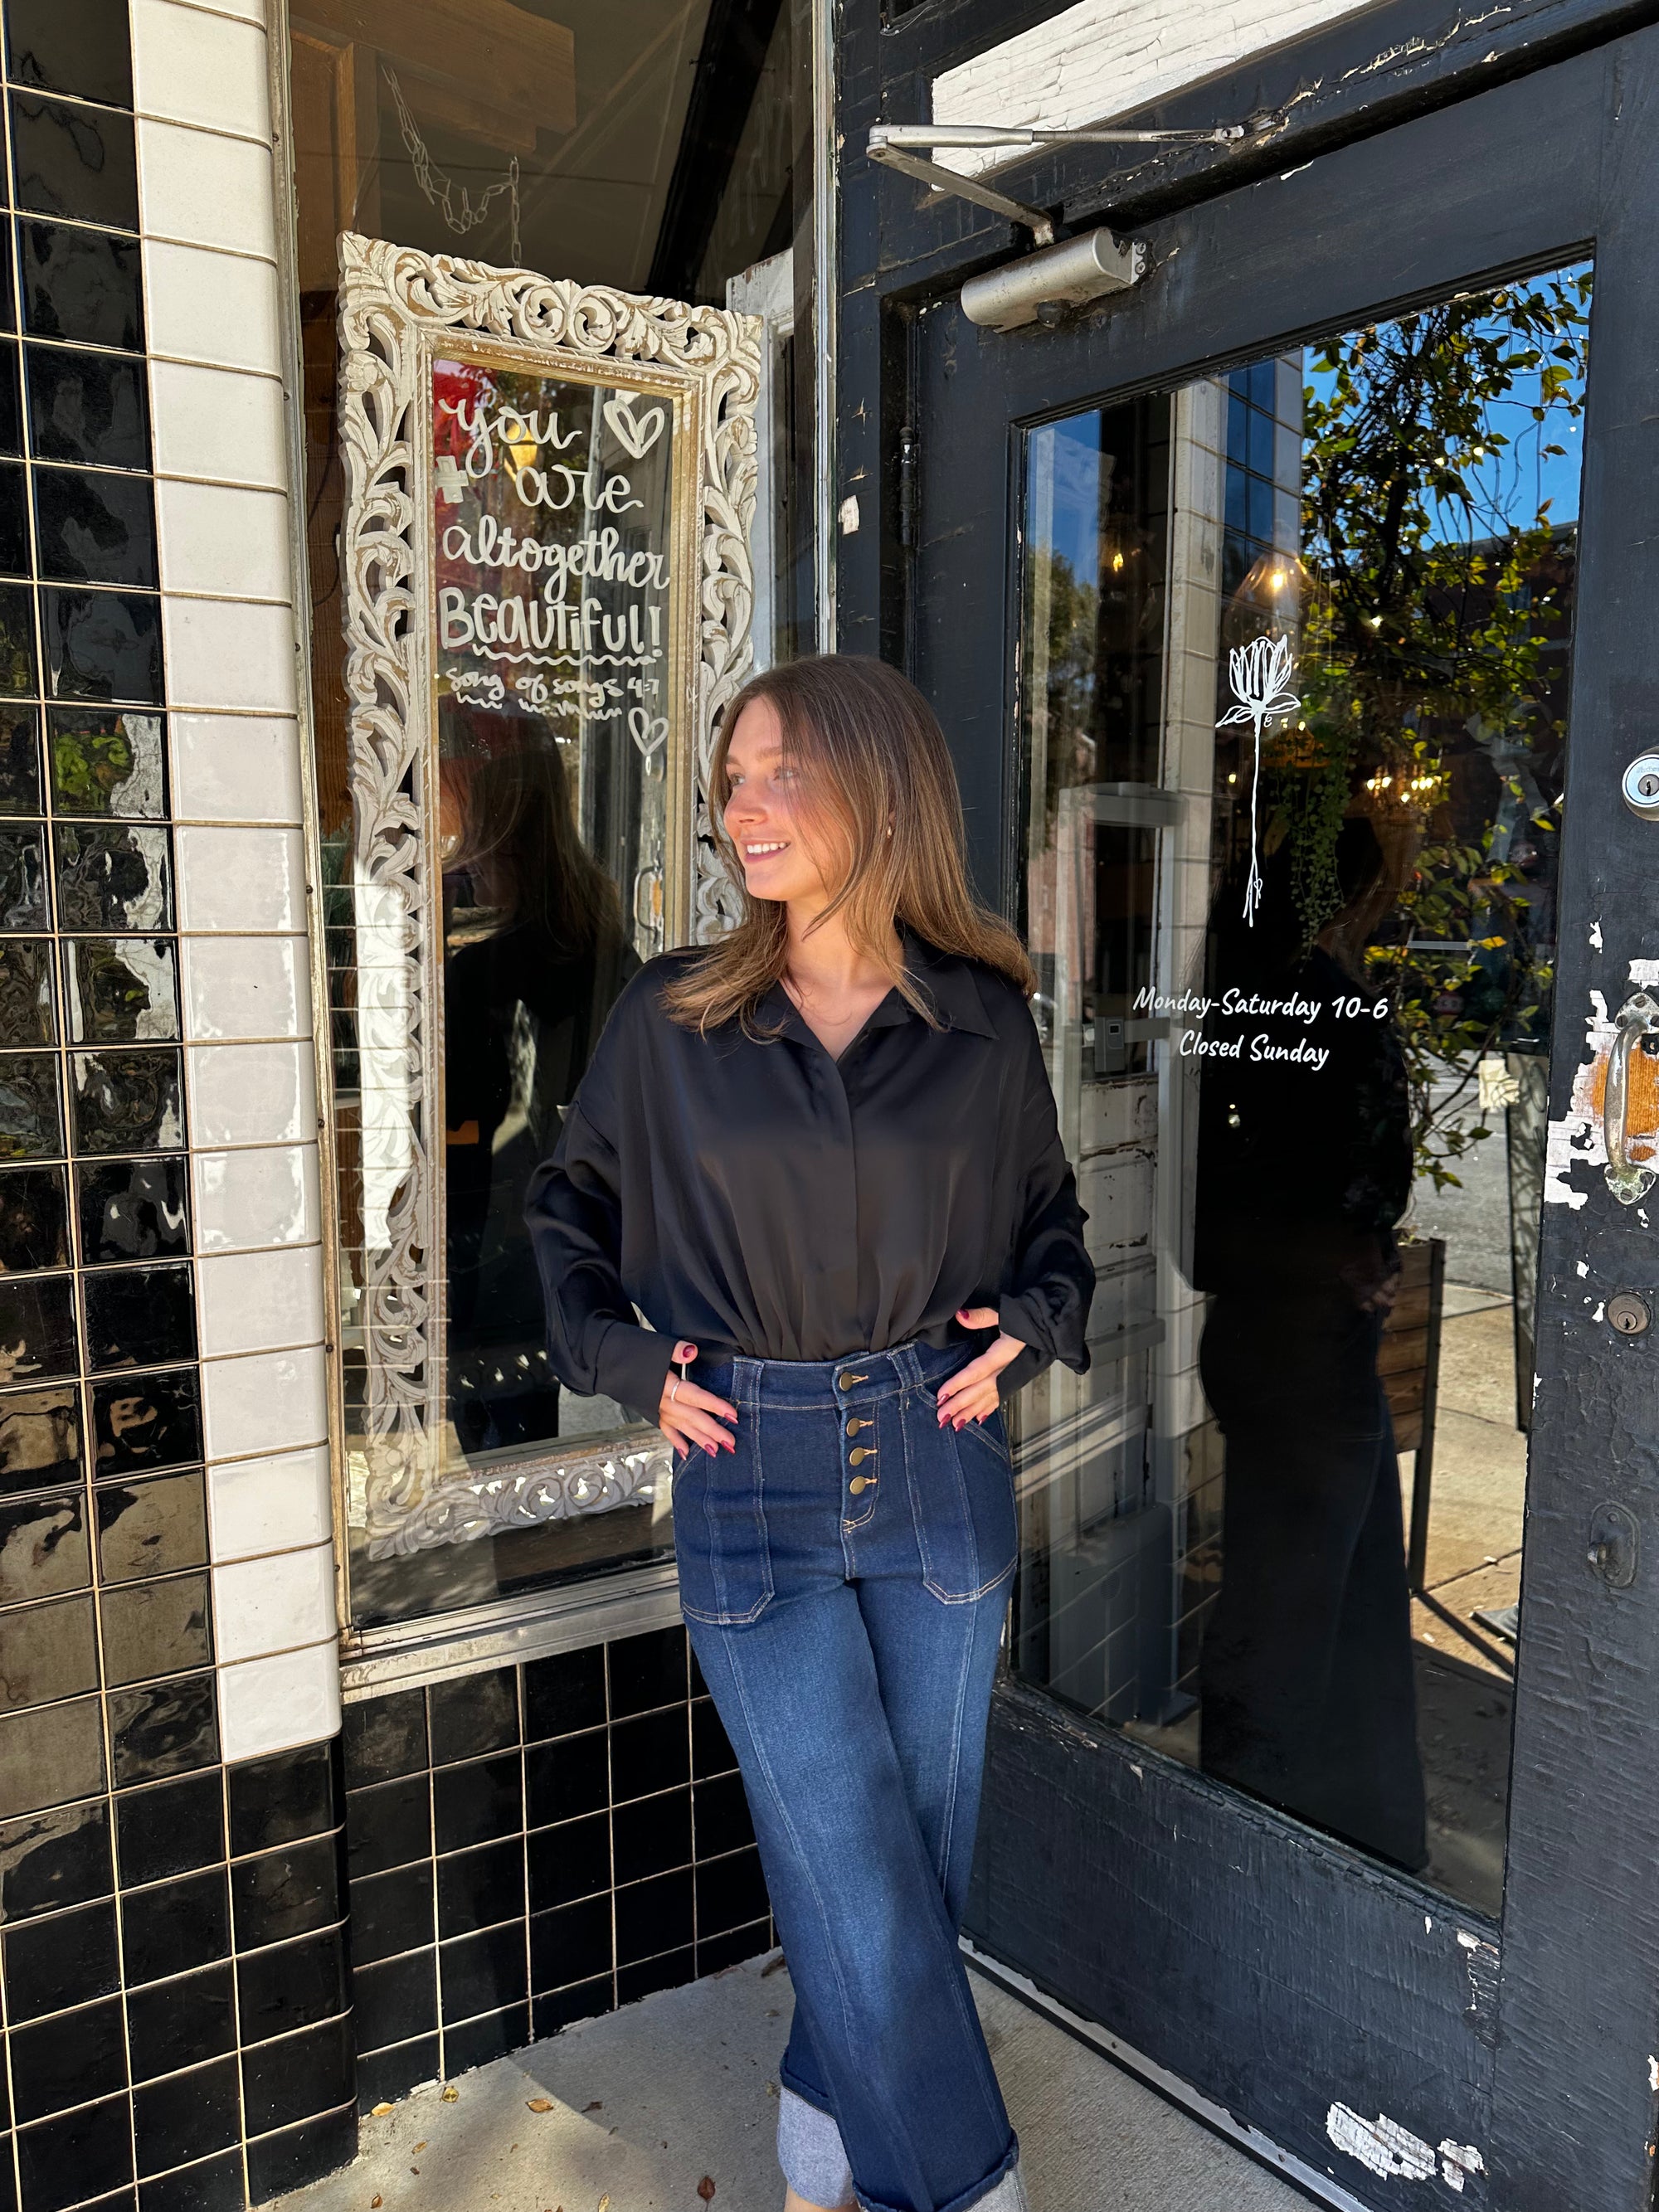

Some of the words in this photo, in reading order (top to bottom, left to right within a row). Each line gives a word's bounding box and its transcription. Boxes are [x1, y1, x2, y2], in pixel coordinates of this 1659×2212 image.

[440, 398, 583, 479] you
[515, 464, 645, 513] are
[442, 514, 670, 605] altogether
[514, 673, 549, 703] of
[627, 677, 660, 698] 4:7
[1132, 986, 1321, 1024] Monday-Saturday
[1331, 995, 1389, 1019] 10-6
[1179, 1029, 1245, 1058] Closed
[1249, 1033, 1331, 1072] Sunday
